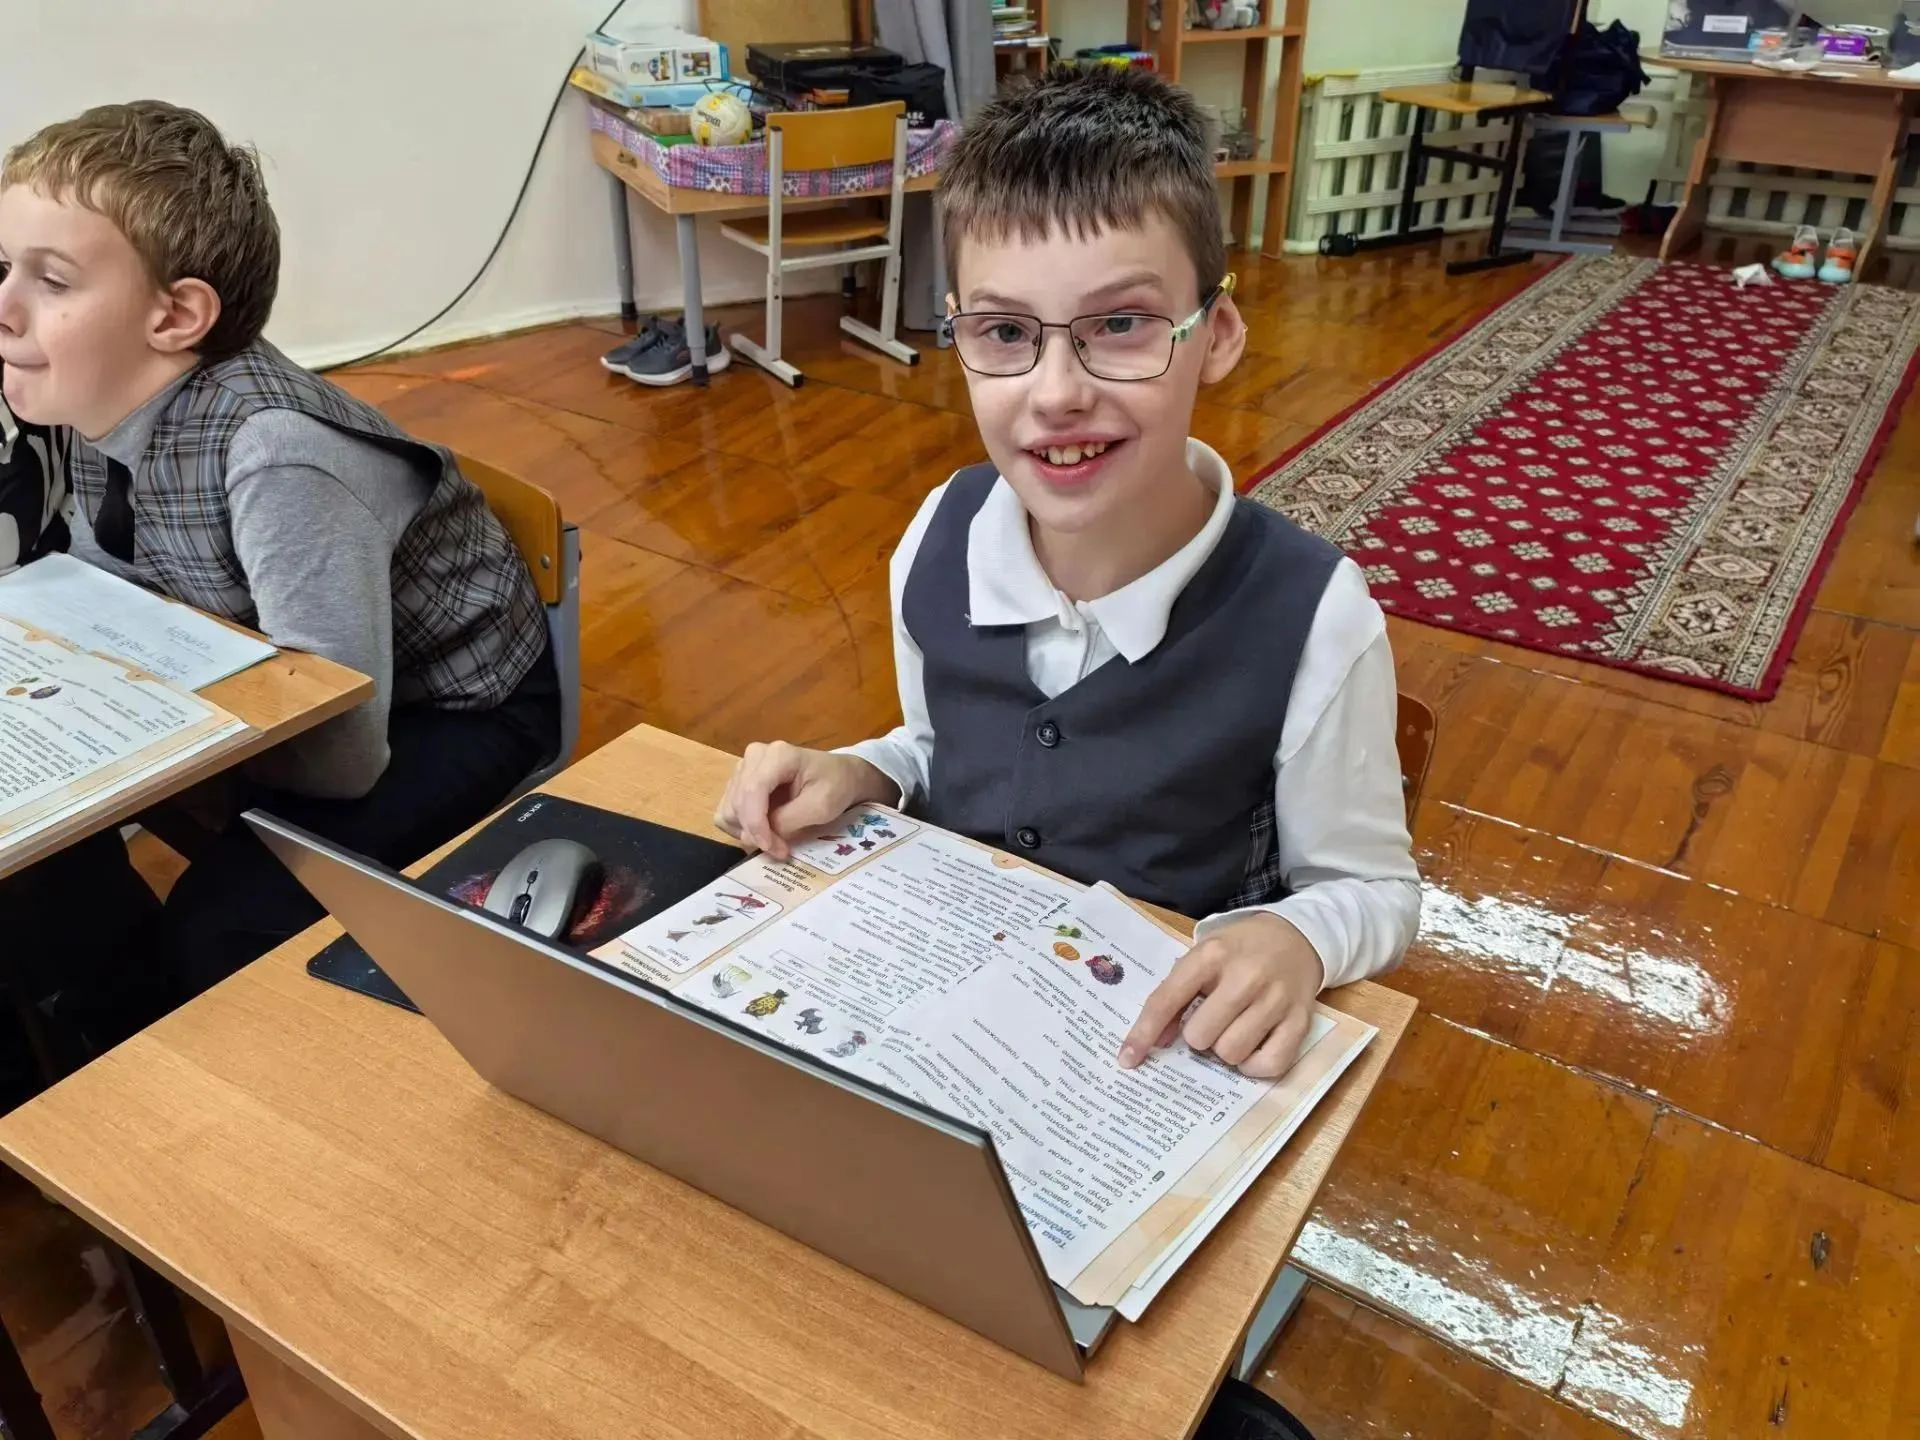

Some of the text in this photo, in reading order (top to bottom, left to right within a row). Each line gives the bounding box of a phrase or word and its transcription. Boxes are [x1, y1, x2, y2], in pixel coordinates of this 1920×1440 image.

[988, 1118, 1015, 1142] Артур
[1054, 1168, 1114, 1208] Артур ничего
[1071, 1189, 1106, 1214] Наташа
